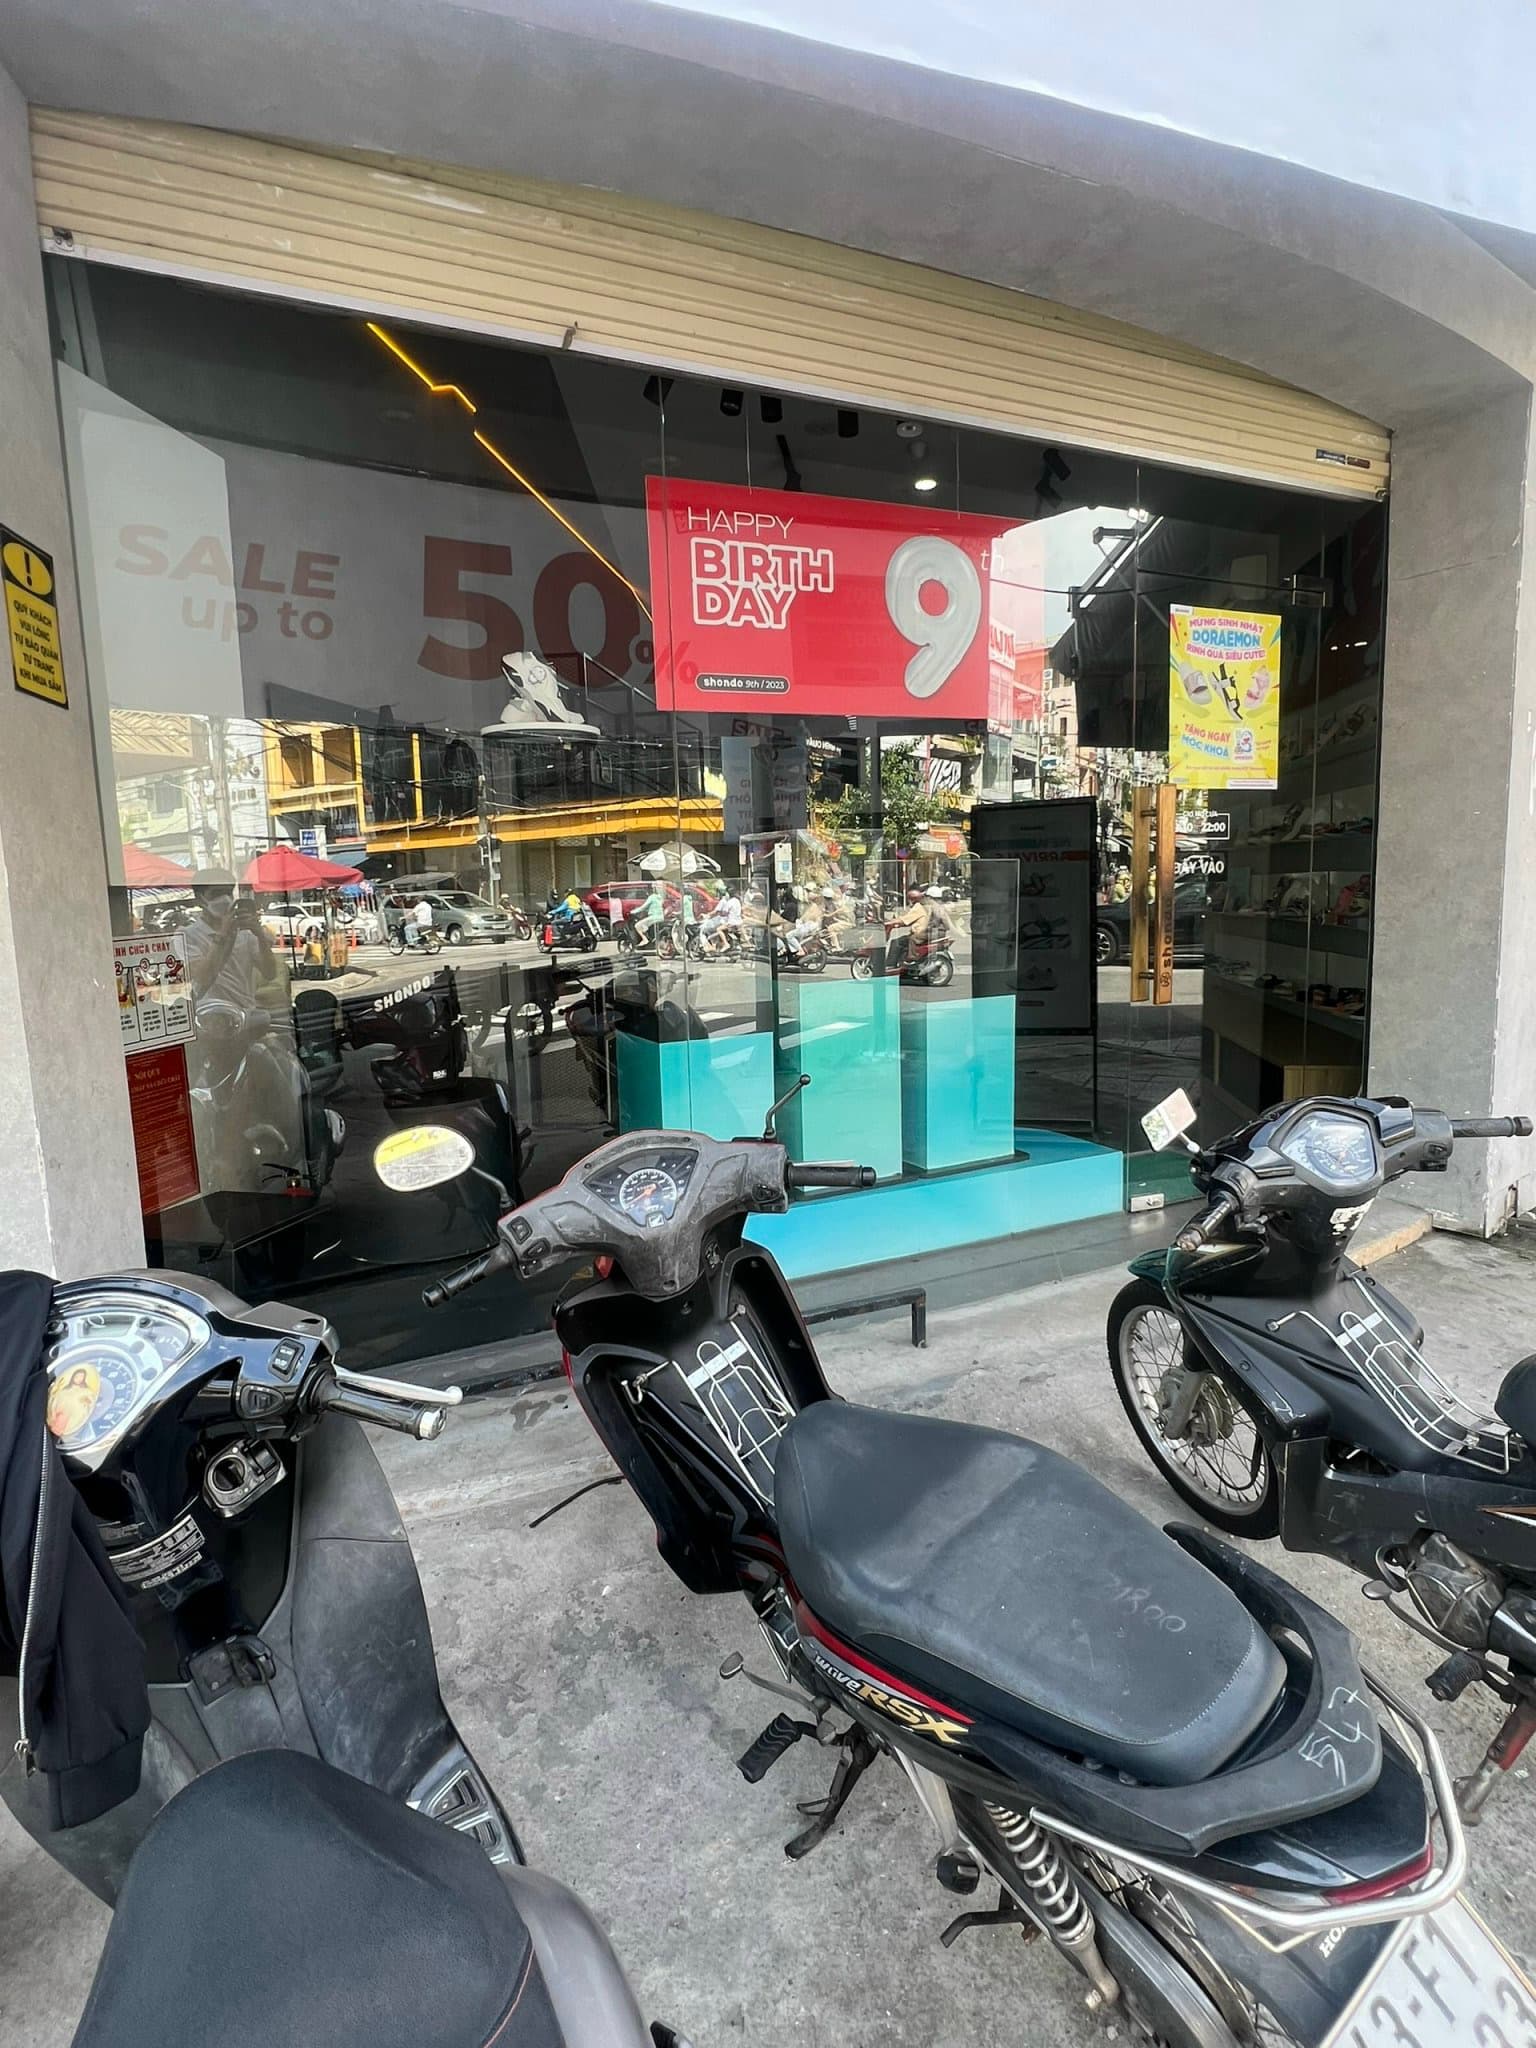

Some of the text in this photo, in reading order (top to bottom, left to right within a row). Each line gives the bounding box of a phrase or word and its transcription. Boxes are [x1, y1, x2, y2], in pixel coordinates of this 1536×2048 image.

[688, 506, 794, 539] HAPPY
[114, 523, 341, 600] SALE
[690, 537, 835, 593] BIRTH
[181, 596, 334, 643] up to
[692, 581, 797, 630] DAY
[1217, 617, 1239, 629] SINH
[1191, 629, 1261, 648] DORAEMON
[703, 677, 743, 688] shondo
[745, 679, 760, 689] 9th
[765, 680, 785, 690] 2023
[1207, 731, 1231, 744] NGAY
[1201, 822, 1226, 832] 22:00
[373, 975, 431, 1013] SHONDO
[857, 1682, 969, 1745] RSX
